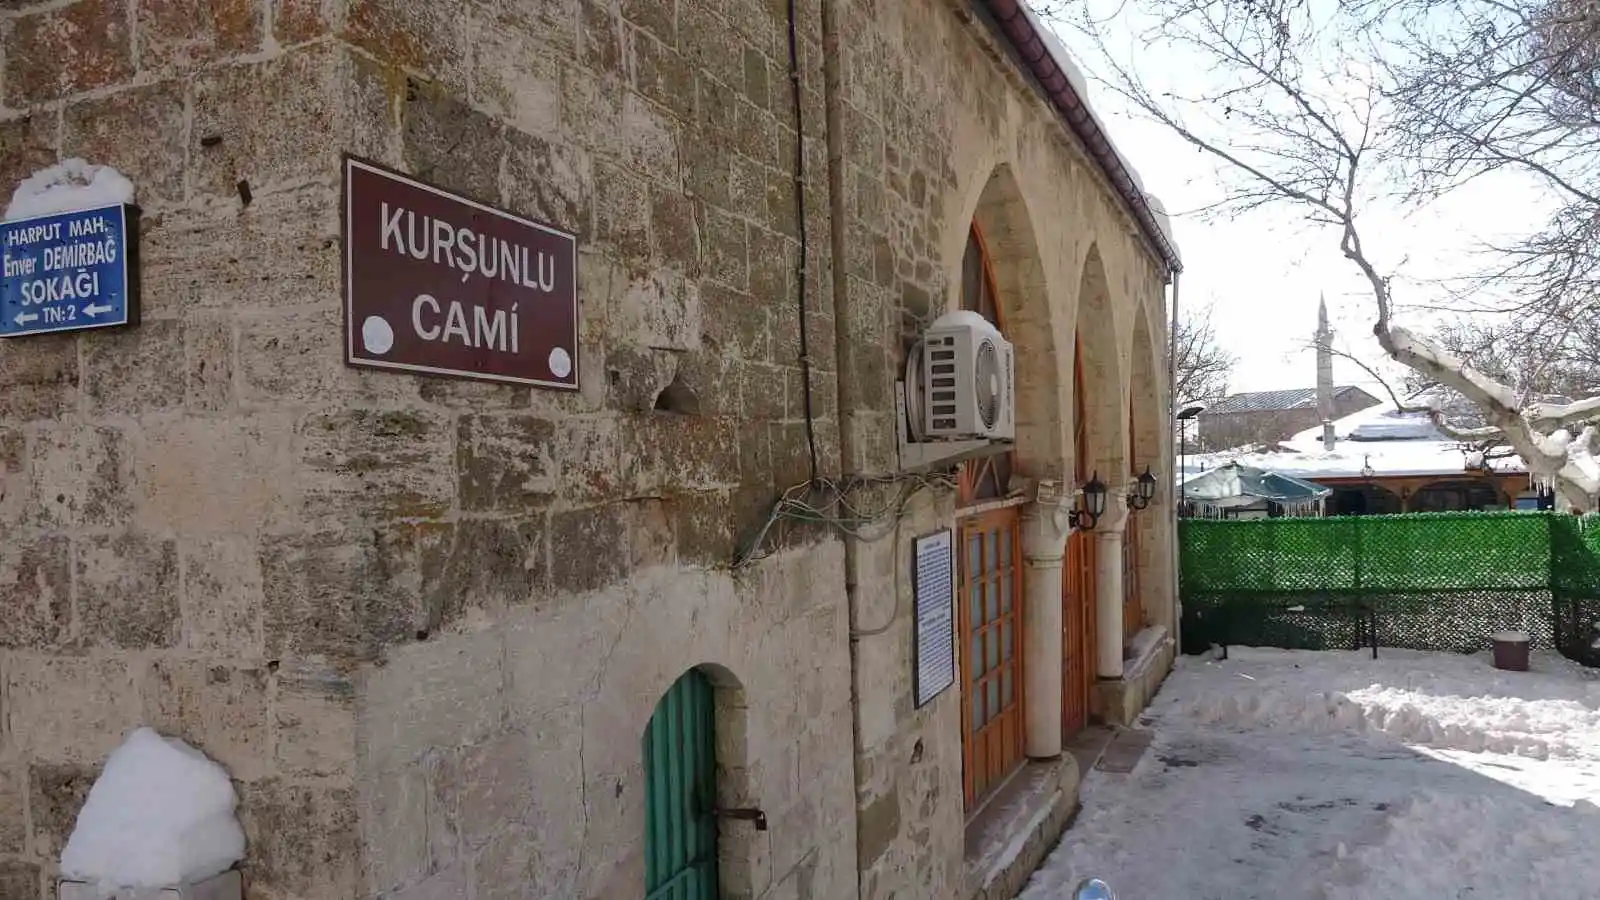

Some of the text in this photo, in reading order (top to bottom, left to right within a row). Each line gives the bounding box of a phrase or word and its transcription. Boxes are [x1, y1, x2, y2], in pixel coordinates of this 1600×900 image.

[8, 215, 109, 247] HARPUT MAH.
[381, 202, 555, 293] KURŞUNLU
[3, 236, 116, 277] Enver DEMİRBAĞ
[20, 268, 100, 306] SOKAĞI
[42, 305, 77, 324] TN:2
